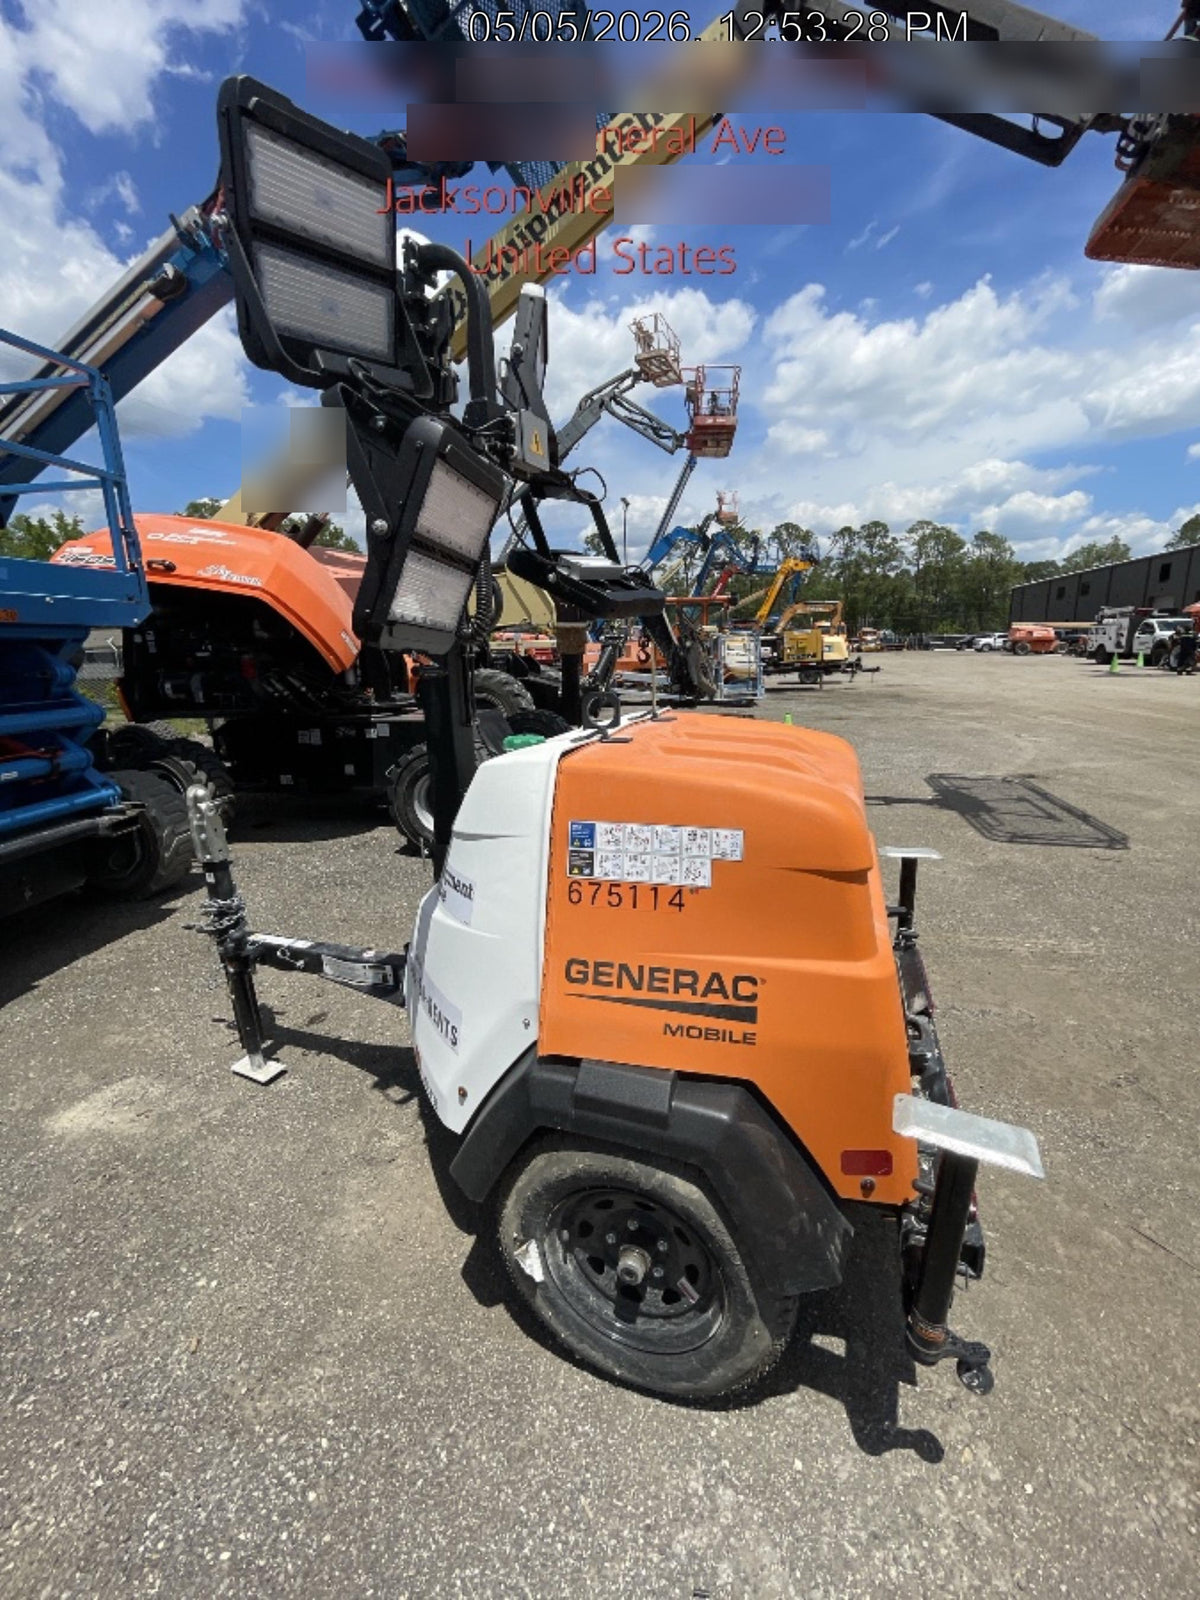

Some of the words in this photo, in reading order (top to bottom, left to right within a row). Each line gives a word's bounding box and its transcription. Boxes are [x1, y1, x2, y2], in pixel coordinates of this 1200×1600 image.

[568, 880, 686, 912] 675114
[565, 957, 758, 1003] GENERAC
[663, 1022, 757, 1046] MOBILE
